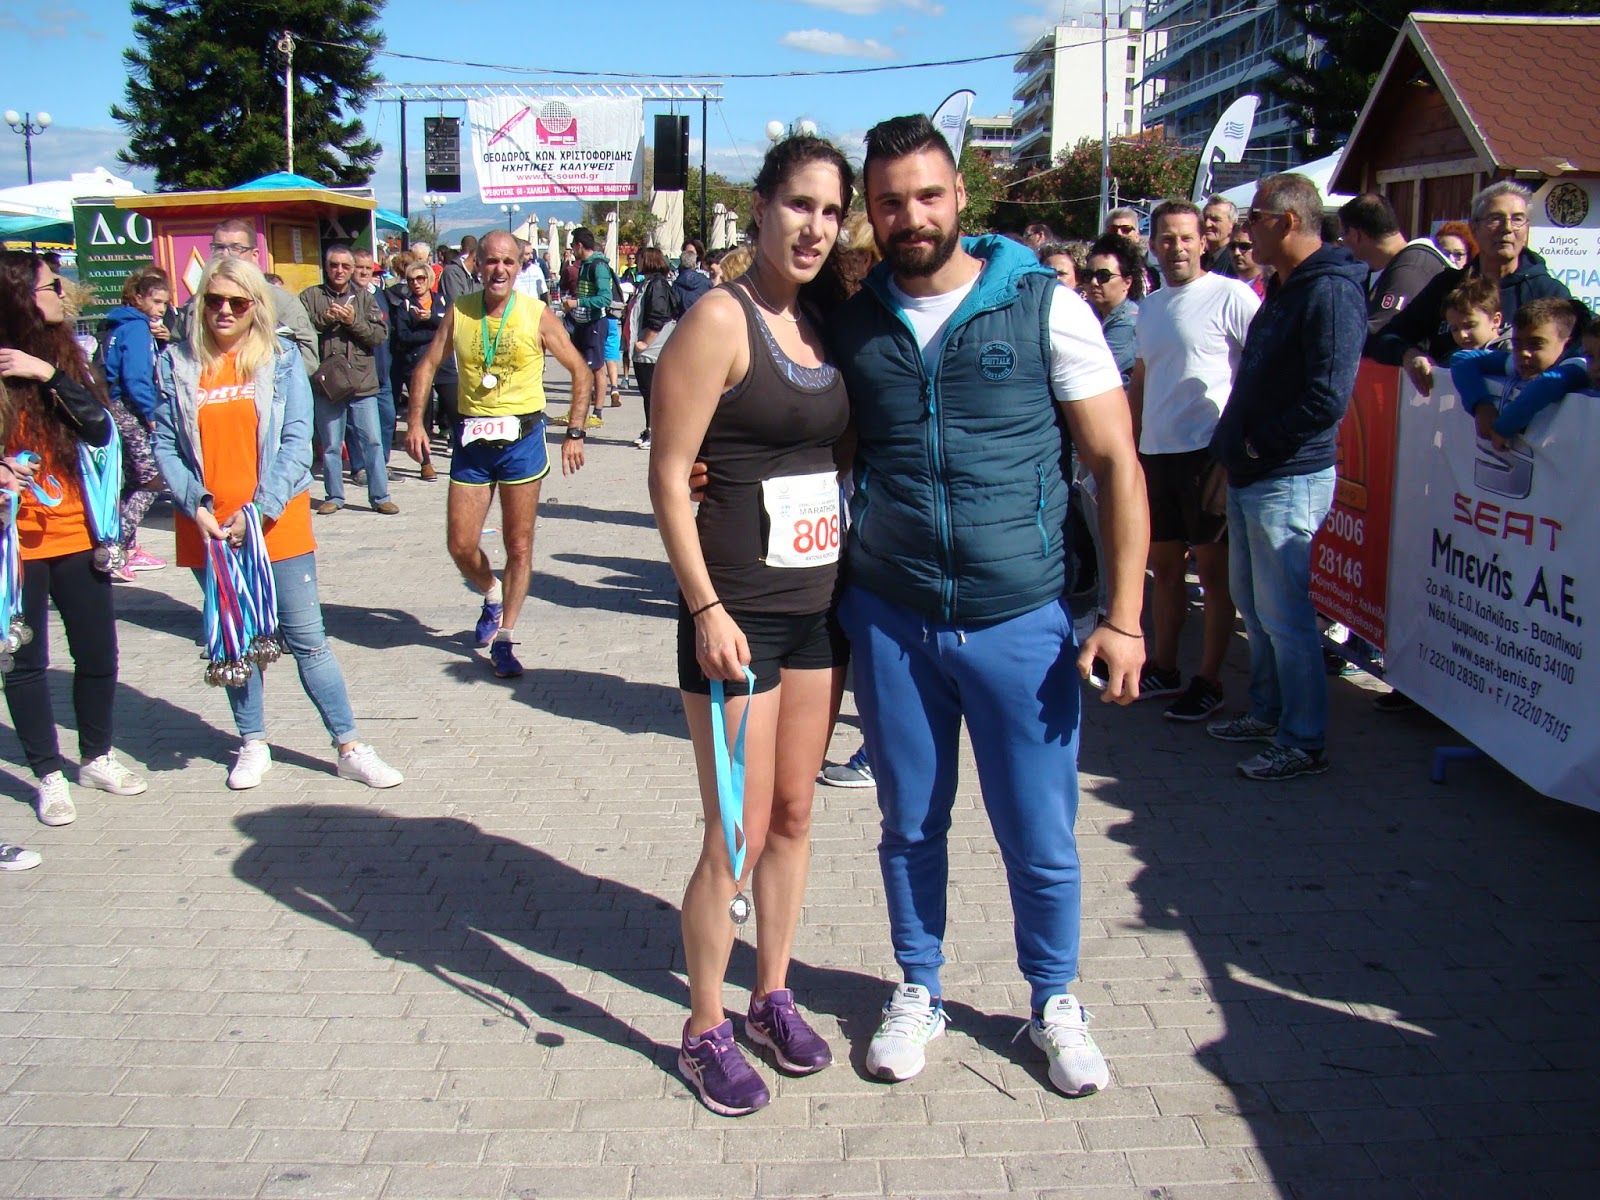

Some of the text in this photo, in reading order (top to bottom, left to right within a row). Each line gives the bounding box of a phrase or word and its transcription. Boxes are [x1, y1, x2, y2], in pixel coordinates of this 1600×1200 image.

[484, 150, 633, 163] ΘΕΟΔΩΡΟΣ ΚΩΝ. ΧΡΙΣΤΟΦΟΡΙΔΗΣ
[502, 162, 615, 172] ΗΧΗΤΙΚΕΣ ΚΑΛΥΨΕΙΣ
[516, 172, 600, 181] www.tc-sound.gr
[1539, 246, 1588, 256] Χαλκιδέων
[1549, 236, 1579, 247] Δήμος
[472, 421, 505, 436] 601
[799, 504, 836, 515] MARATHON
[1326, 508, 1364, 546] 5006
[1453, 492, 1562, 552] SEAT
[793, 514, 839, 553] 808
[1318, 543, 1363, 589] 28146
[1431, 527, 1583, 628] Μπενής Α.Ε.
[1428, 600, 1446, 624] Νέα
[1495, 633, 1542, 669] Χαλκίδα
[1543, 653, 1575, 685] 34100
[1531, 621, 1583, 661] Βασιλικού
[1451, 639, 1543, 698] www.seat-benis.gr
[1429, 649, 1456, 677] 22210
[1457, 664, 1485, 694] 28350
[1512, 694, 1543, 725] 22210
[1540, 711, 1572, 743] 75115
